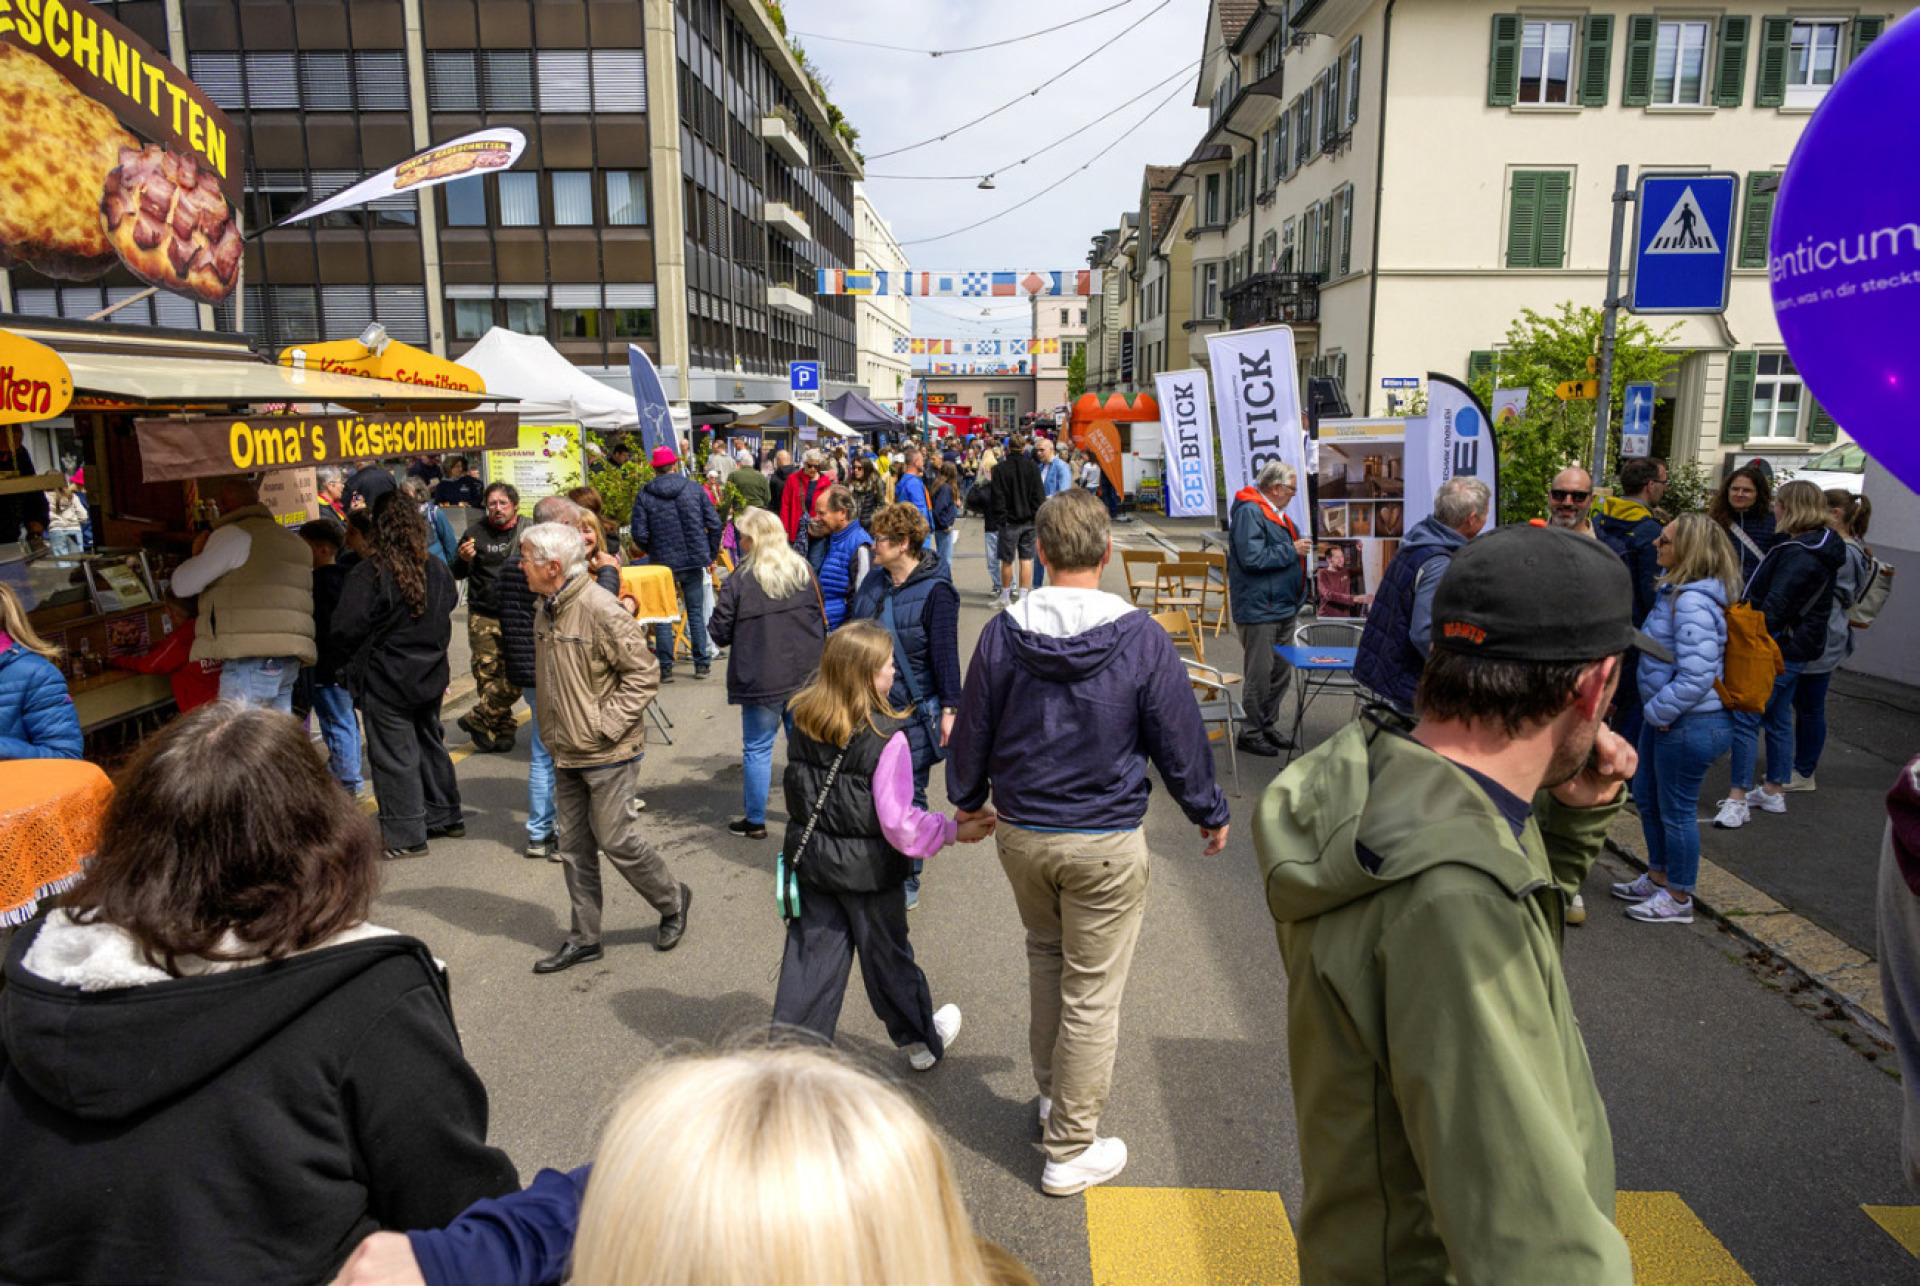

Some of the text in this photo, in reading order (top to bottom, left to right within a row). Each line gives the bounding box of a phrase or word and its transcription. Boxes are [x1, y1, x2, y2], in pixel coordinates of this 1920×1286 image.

[1821, 286, 1834, 300] in
[1836, 281, 1857, 298] dir
[1861, 270, 1920, 293] steckt
[337, 415, 486, 458] Käseschnitten
